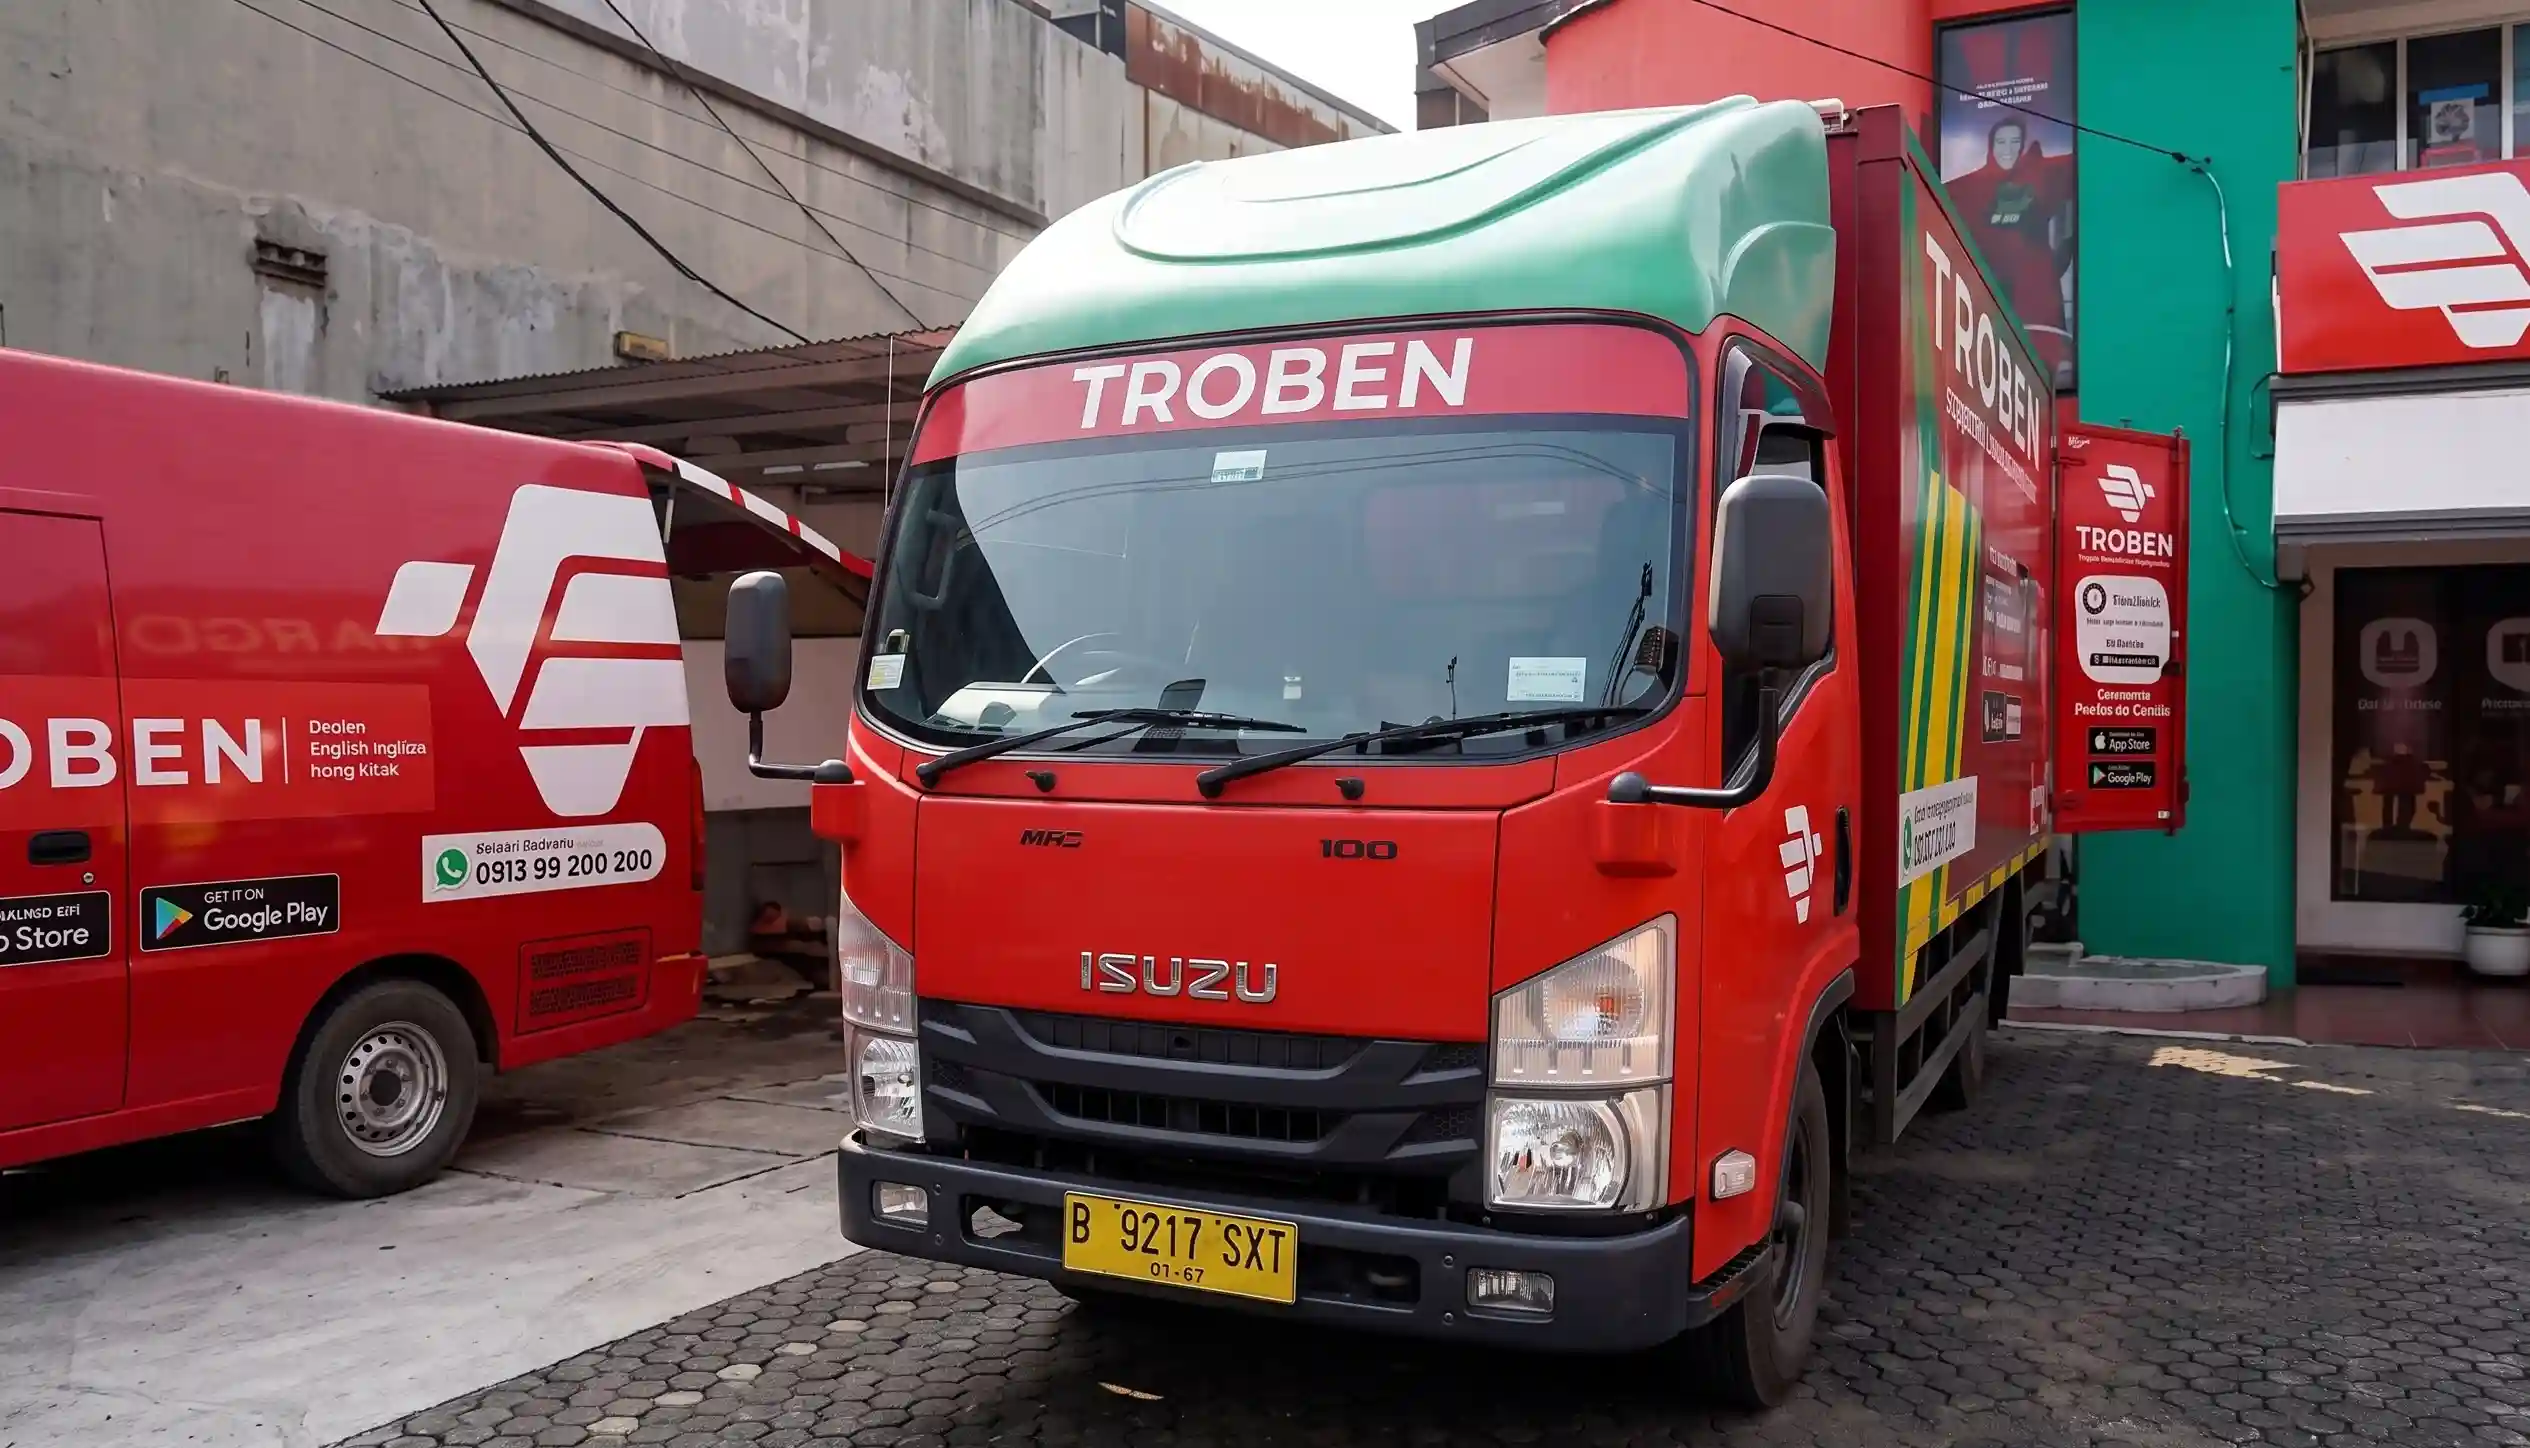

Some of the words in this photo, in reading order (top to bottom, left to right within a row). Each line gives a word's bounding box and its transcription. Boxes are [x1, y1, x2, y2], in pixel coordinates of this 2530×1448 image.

[1926, 230, 2040, 472] TROBEN
[1072, 337, 1474, 430] TROBEN
[2076, 525, 2173, 557] TROBEN
[310, 740, 369, 760] English
[2109, 738, 2127, 752] App
[2128, 738, 2151, 750] Store
[310, 763, 355, 781] hong
[2107, 771, 2135, 786] Google
[2136, 771, 2153, 785] Play
[1319, 839, 1398, 860] 100
[534, 856, 561, 880] 99
[567, 852, 608, 877] 200
[613, 849, 652, 873] 200
[204, 890, 230, 904] GET
[232, 889, 242, 901] IT
[244, 888, 264, 901] ON
[204, 904, 282, 933] Google
[287, 901, 329, 927] Play
[16, 926, 91, 951] Store
[1080, 951, 1278, 1003] ISUZU
[1071, 1201, 1091, 1244] B
[1120, 1208, 1202, 1260] 9217
[1222, 1223, 1287, 1274] SXT
